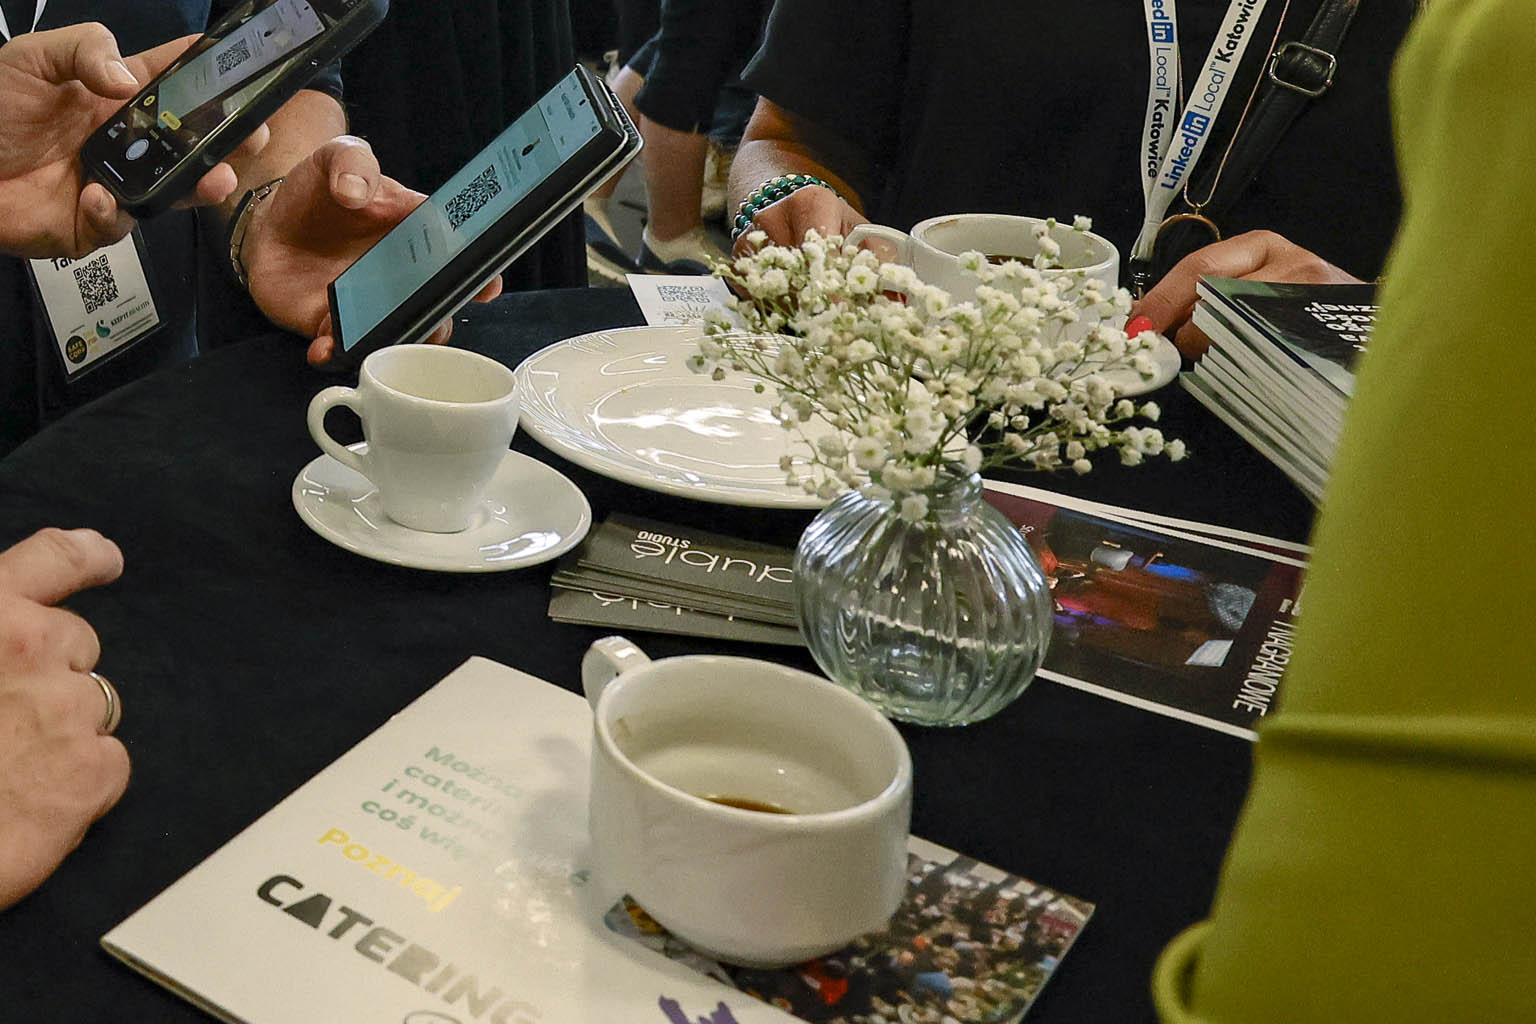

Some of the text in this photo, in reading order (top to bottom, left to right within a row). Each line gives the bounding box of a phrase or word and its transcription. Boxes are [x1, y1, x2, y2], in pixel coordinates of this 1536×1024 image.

[1147, 98, 1170, 179] Katowice
[637, 530, 691, 550] STUDIO
[256, 874, 544, 1024] CATERING
